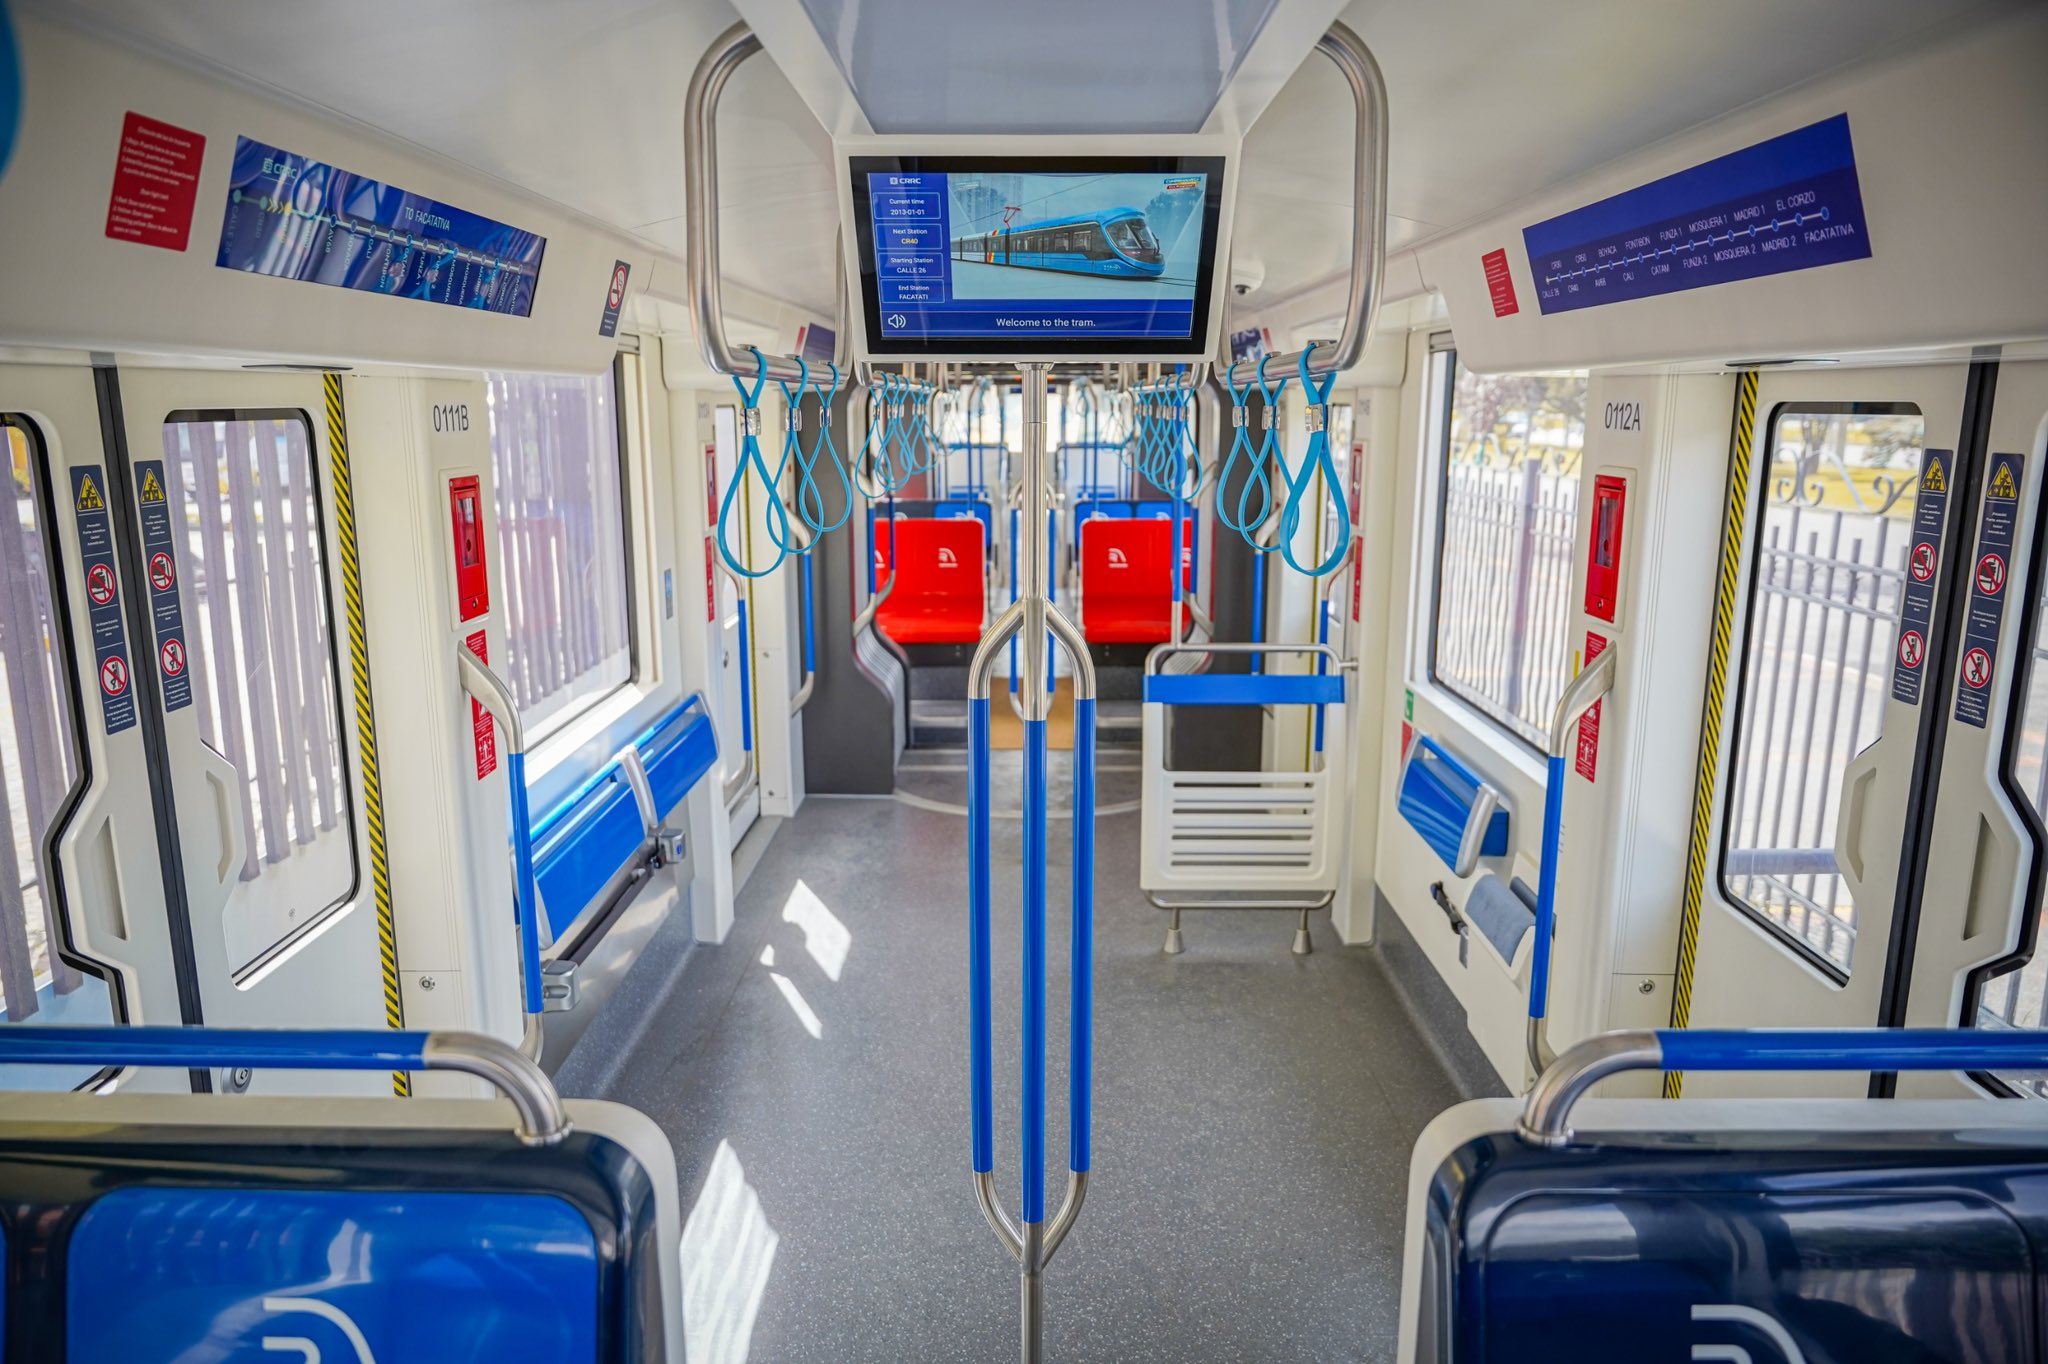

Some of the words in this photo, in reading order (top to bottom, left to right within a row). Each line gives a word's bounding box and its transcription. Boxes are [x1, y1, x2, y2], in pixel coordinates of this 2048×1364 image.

[1776, 199, 1786, 211] EL
[1787, 190, 1816, 209] CORZO
[405, 206, 414, 220] TO
[415, 210, 450, 231] FACATATIVA
[1733, 206, 1760, 221] MADRID
[1761, 204, 1766, 215] 1
[1689, 216, 1723, 232] MOSQUERA
[1660, 228, 1678, 240] FUNZA
[1804, 223, 1855, 243] FACATATIVA
[366, 239, 374, 259] CALI
[1625, 237, 1651, 249] FONTIBON
[1761, 237, 1789, 252] MADRID
[1791, 235, 1797, 246] 2
[1713, 246, 1750, 262] MOSQUERA
[1751, 243, 1756, 254] 2
[1651, 264, 1670, 275] CATAM
[1683, 258, 1703, 269] FUNZA
[1703, 255, 1708, 265] 2
[996, 318, 1040, 327] Welcome
[1042, 319, 1052, 327] to
[1054, 318, 1070, 327] the
[1071, 319, 1096, 327] tram.
[433, 404, 469, 432] 0111B
[1604, 402, 1641, 431] 0112A
